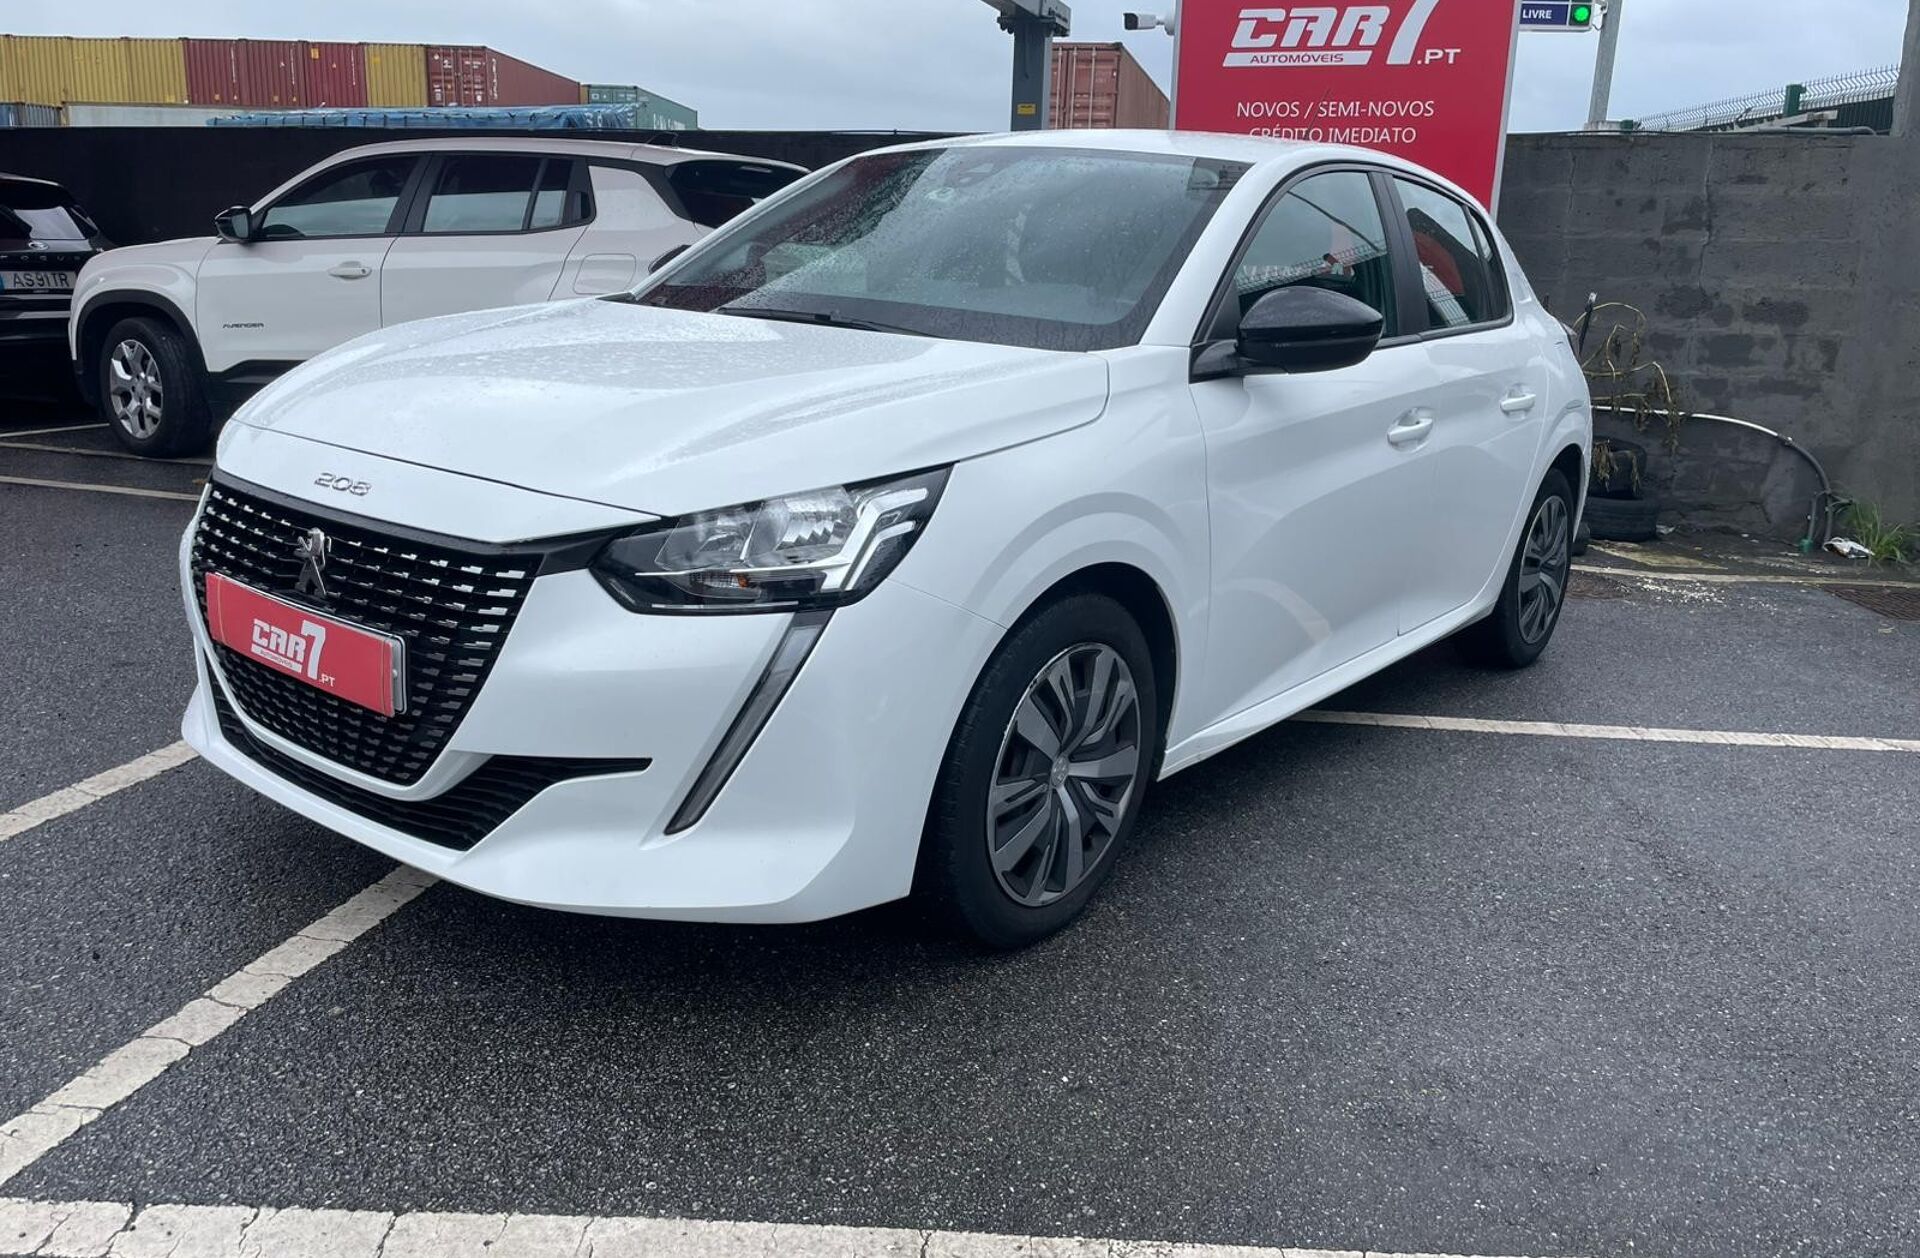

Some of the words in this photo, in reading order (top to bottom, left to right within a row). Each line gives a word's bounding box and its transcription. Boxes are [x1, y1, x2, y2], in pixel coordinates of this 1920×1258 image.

[1522, 9, 1552, 19] LIVRE
[1250, 52, 1344, 64] AUTOMÓVEIS
[1237, 101, 1300, 117] NOVOS
[1317, 100, 1435, 117] SEMI-NOVOS
[1328, 127, 1417, 143] IMEDIATO
[314, 472, 372, 496] 208
